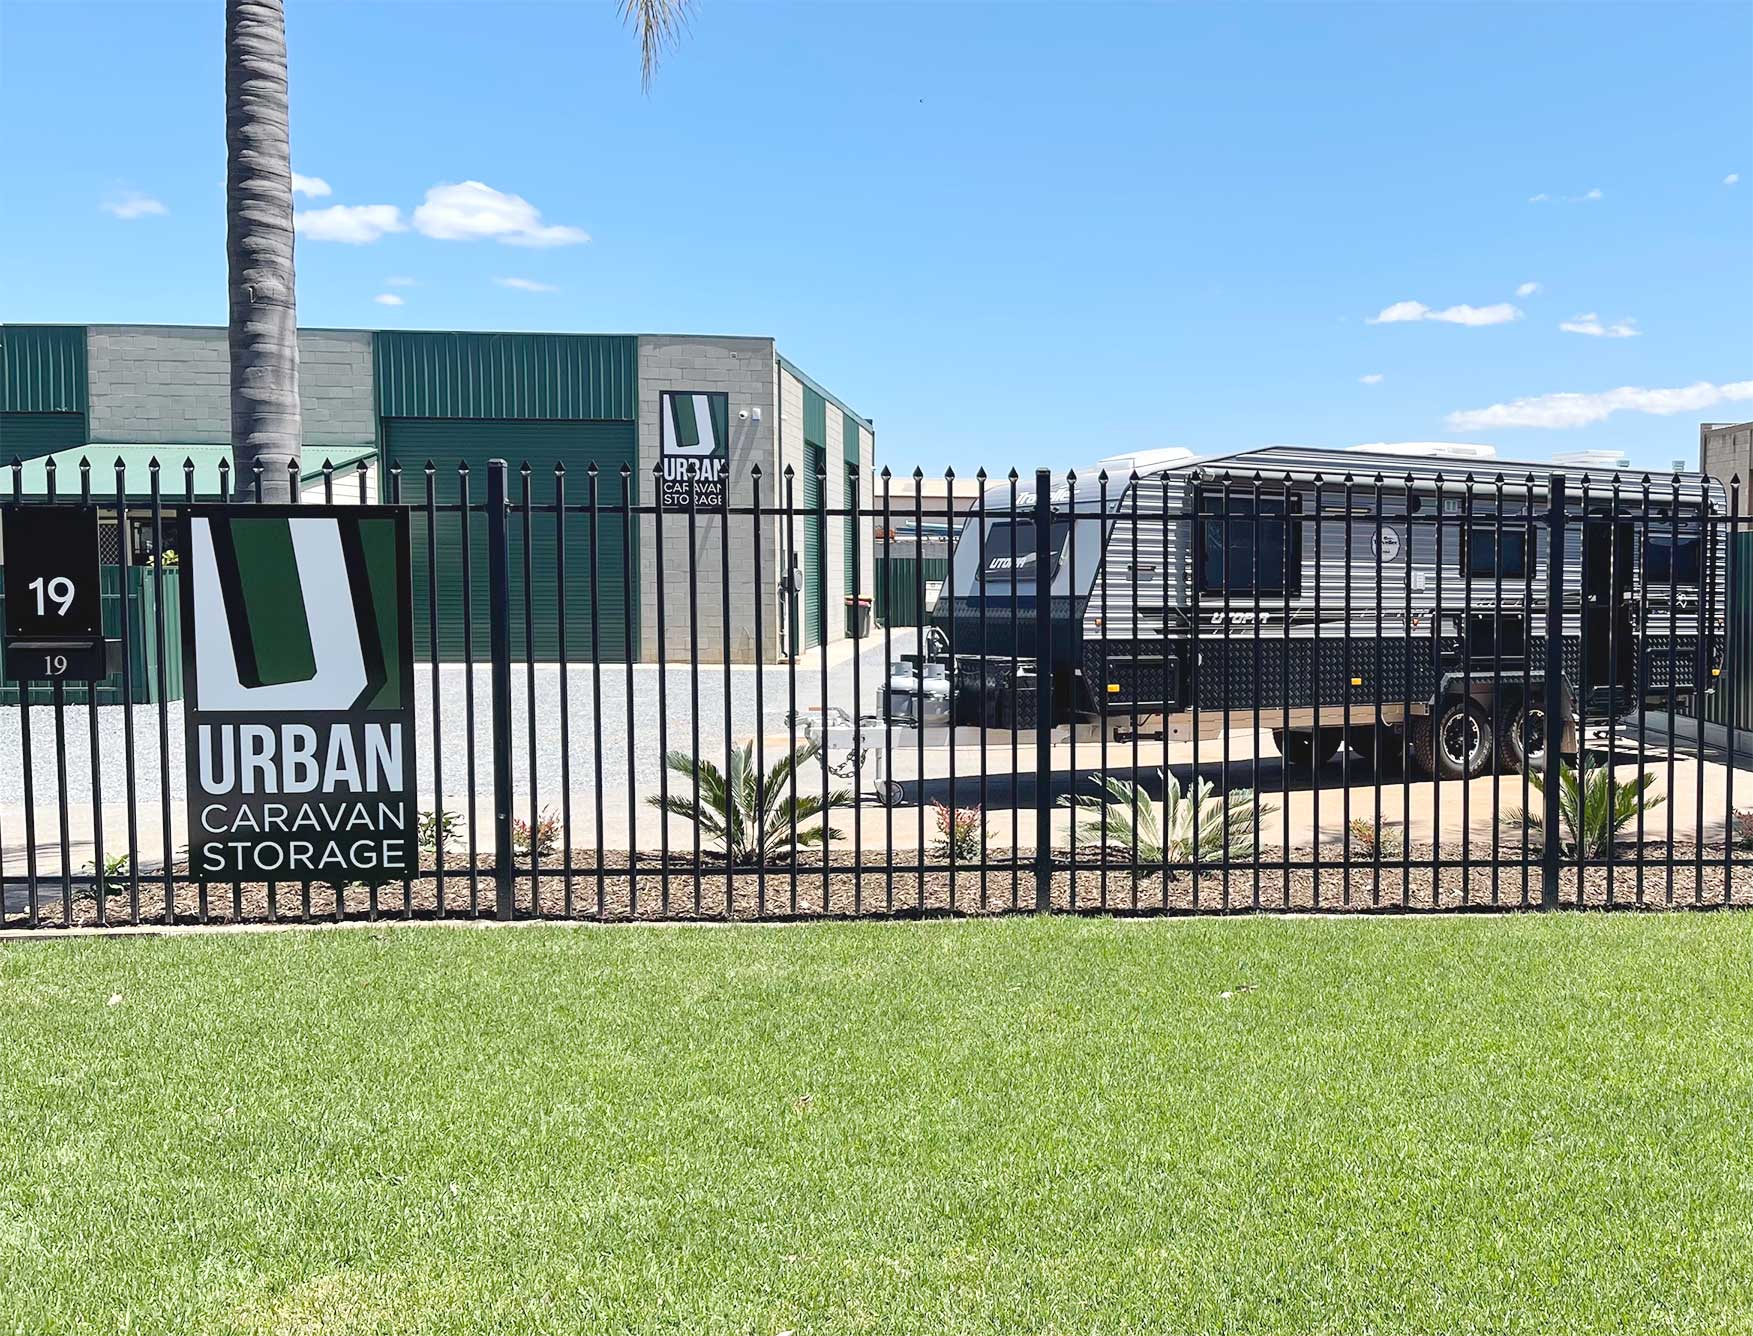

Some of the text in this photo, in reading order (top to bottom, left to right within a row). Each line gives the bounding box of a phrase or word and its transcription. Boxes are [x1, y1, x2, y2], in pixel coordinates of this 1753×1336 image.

[29, 577, 75, 616] 19
[45, 655, 67, 676] 19
[199, 723, 403, 795] URBAN
[201, 802, 405, 834] CARAVAN
[203, 839, 405, 872] STORAGE
